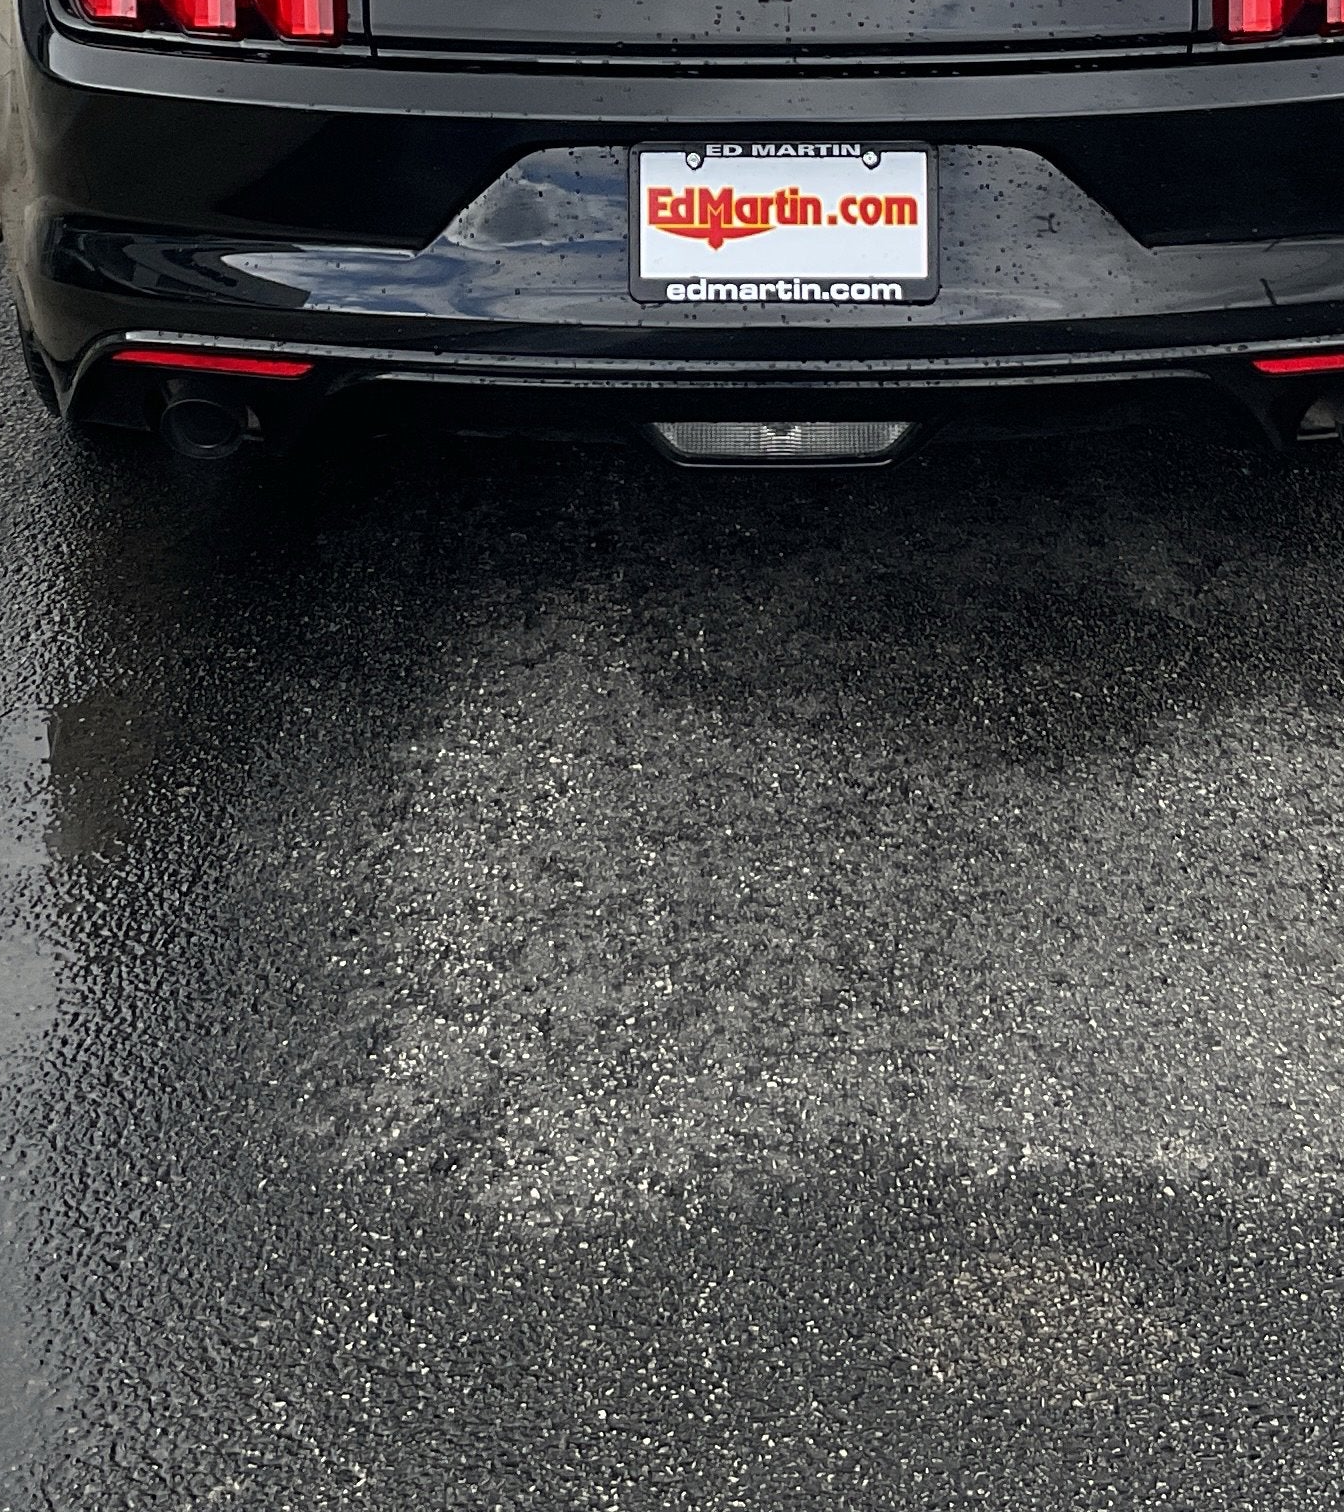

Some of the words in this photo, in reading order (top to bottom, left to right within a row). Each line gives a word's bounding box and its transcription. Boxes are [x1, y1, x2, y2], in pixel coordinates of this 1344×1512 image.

[705, 144, 743, 157] ED
[751, 143, 861, 157] MARTIN
[646, 187, 920, 227] EdMartin.com
[665, 278, 903, 302] edmartin.com
